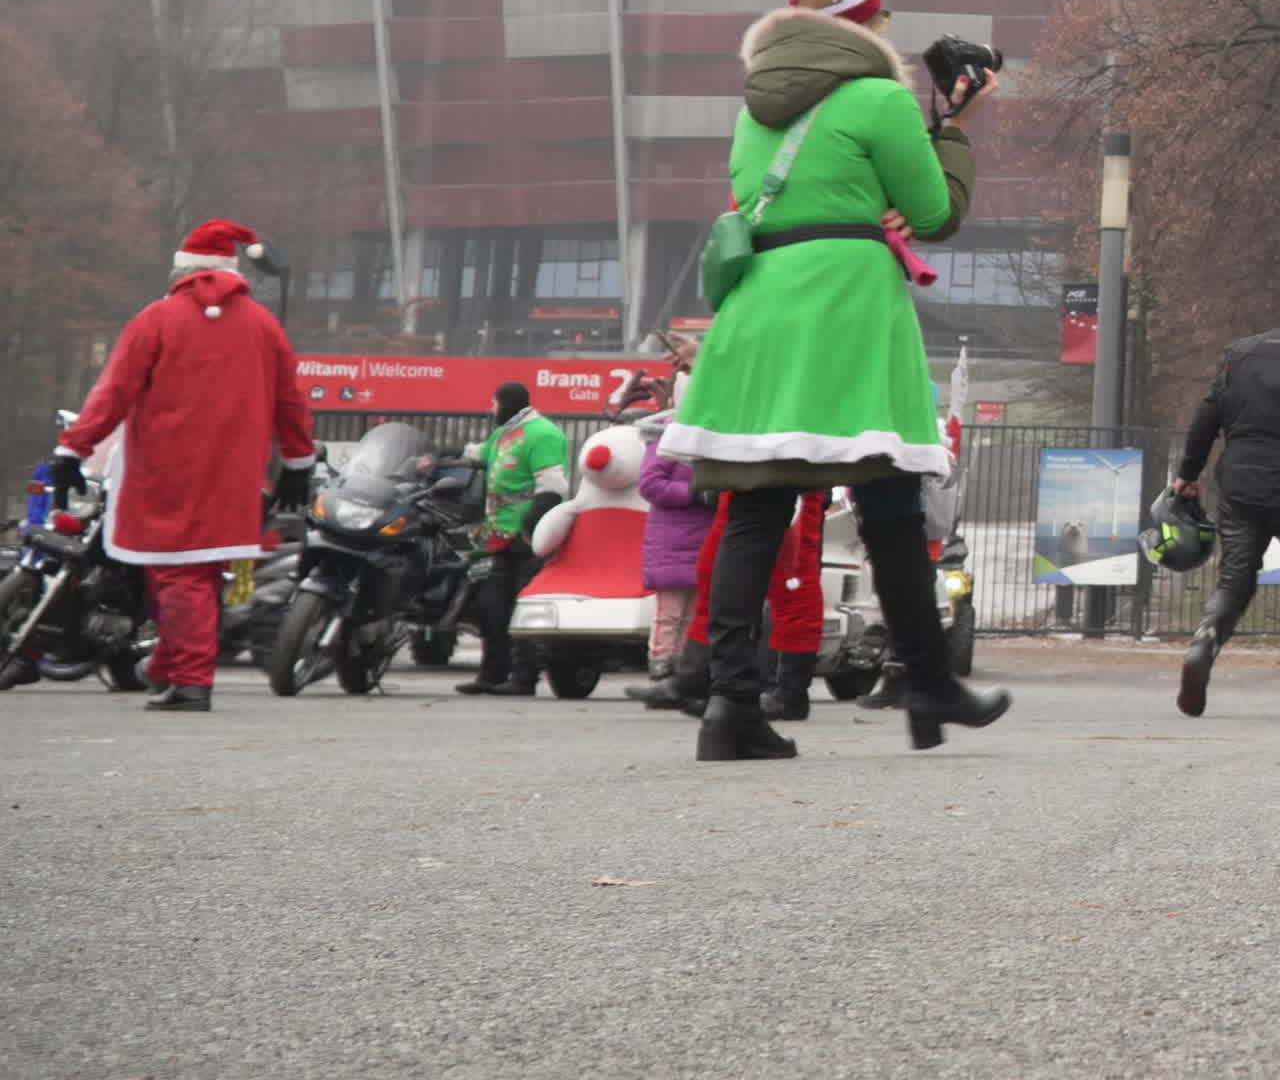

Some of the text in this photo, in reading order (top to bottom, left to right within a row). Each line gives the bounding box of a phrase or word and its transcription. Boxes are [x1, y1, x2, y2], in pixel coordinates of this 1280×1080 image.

[368, 361, 444, 378] Welcome
[536, 369, 601, 388] Brama
[568, 388, 600, 401] Gate
